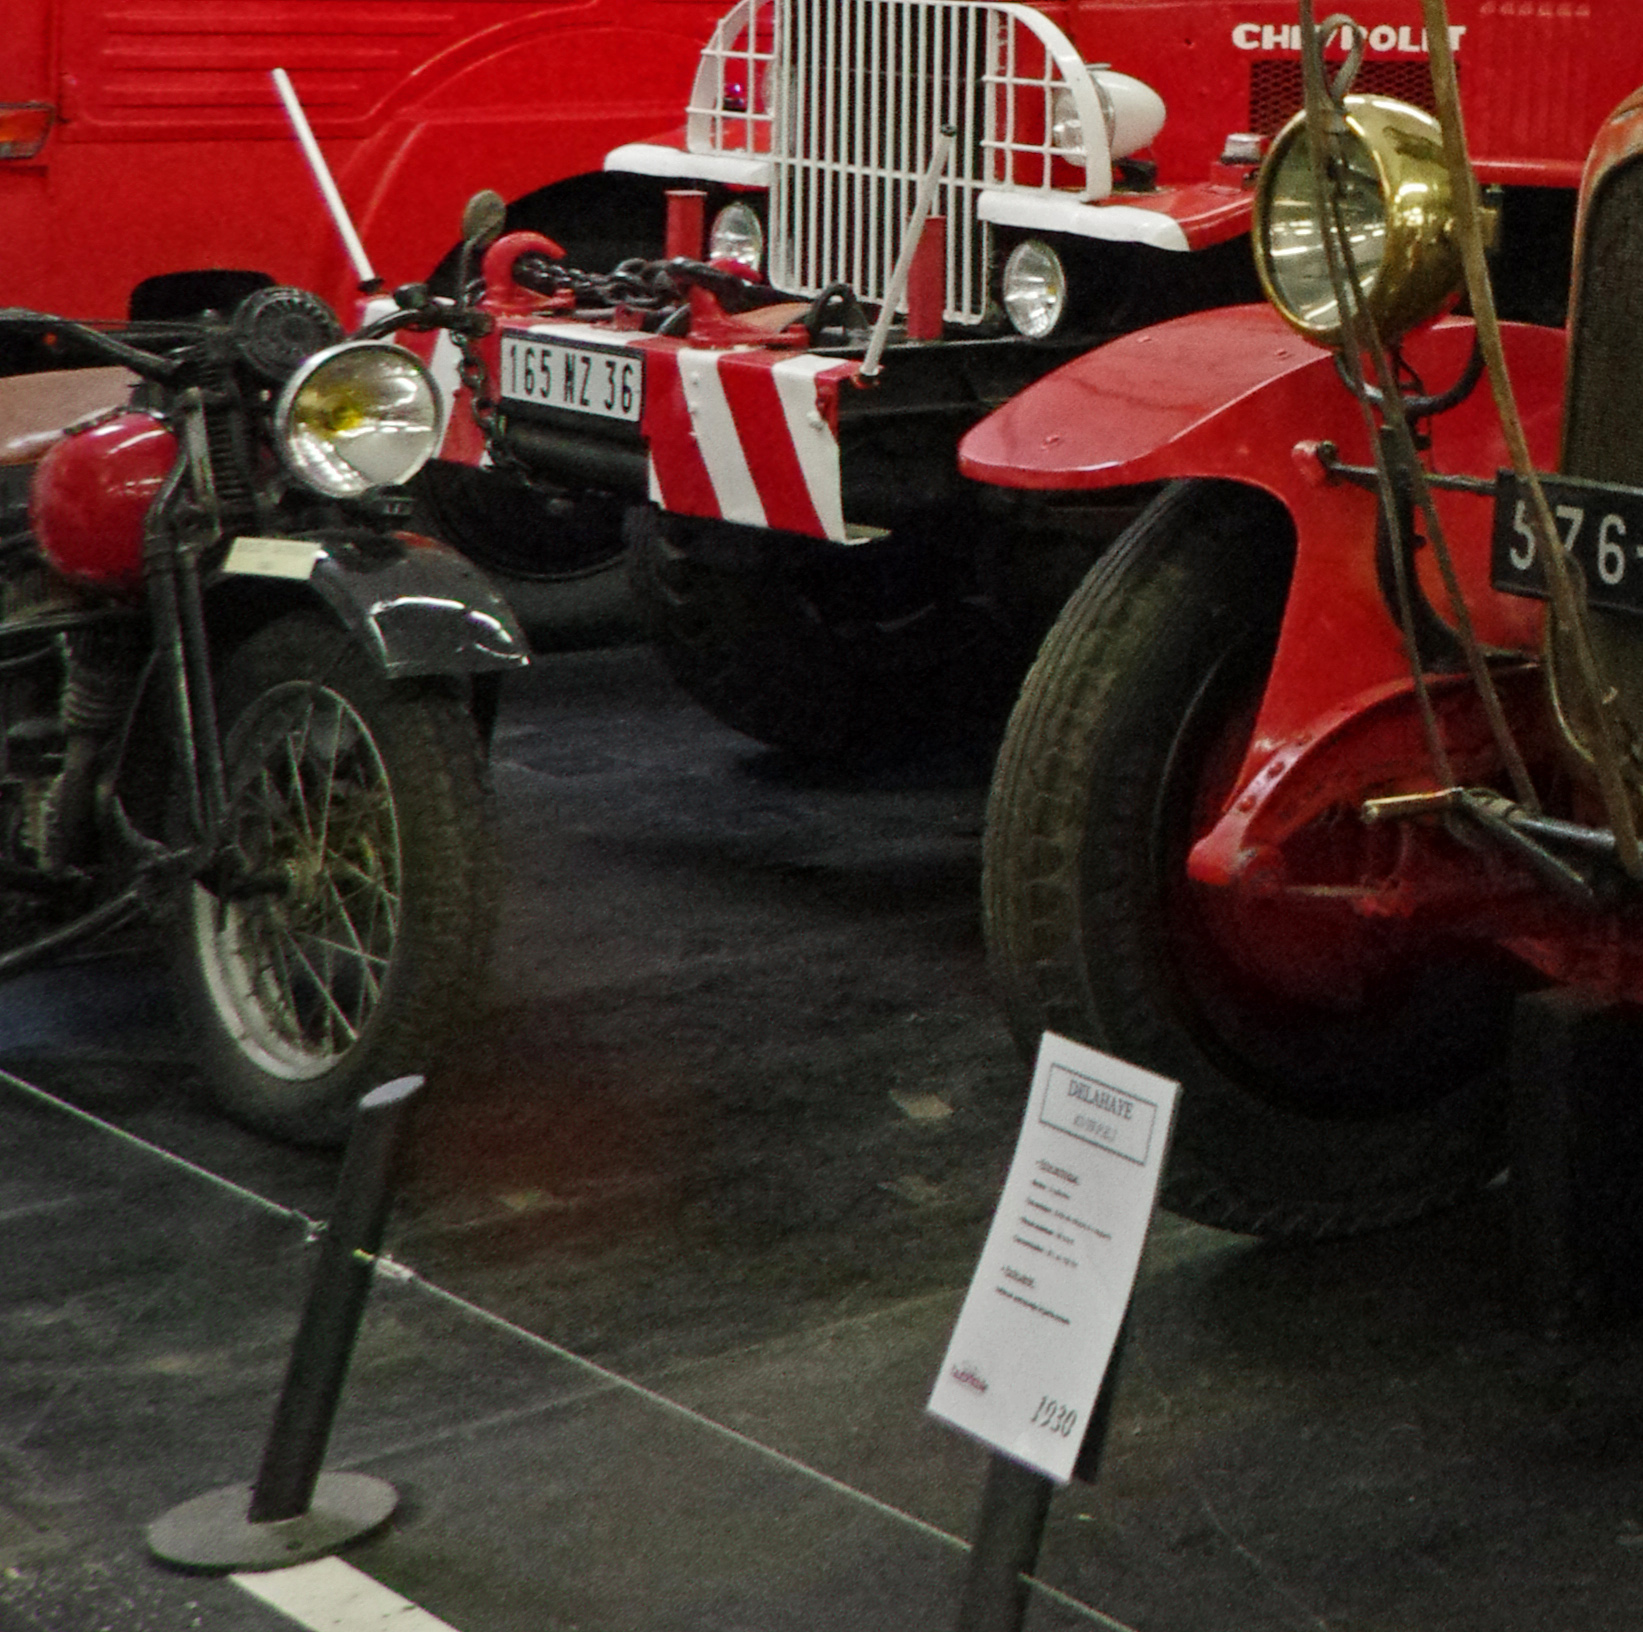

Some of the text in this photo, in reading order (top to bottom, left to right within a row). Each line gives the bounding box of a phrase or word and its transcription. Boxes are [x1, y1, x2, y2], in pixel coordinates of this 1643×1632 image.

[510, 344, 634, 414] 165 NZ 36
[1067, 1078, 1134, 1120] DELAHAYE
[1030, 1394, 1078, 1439] 1930
